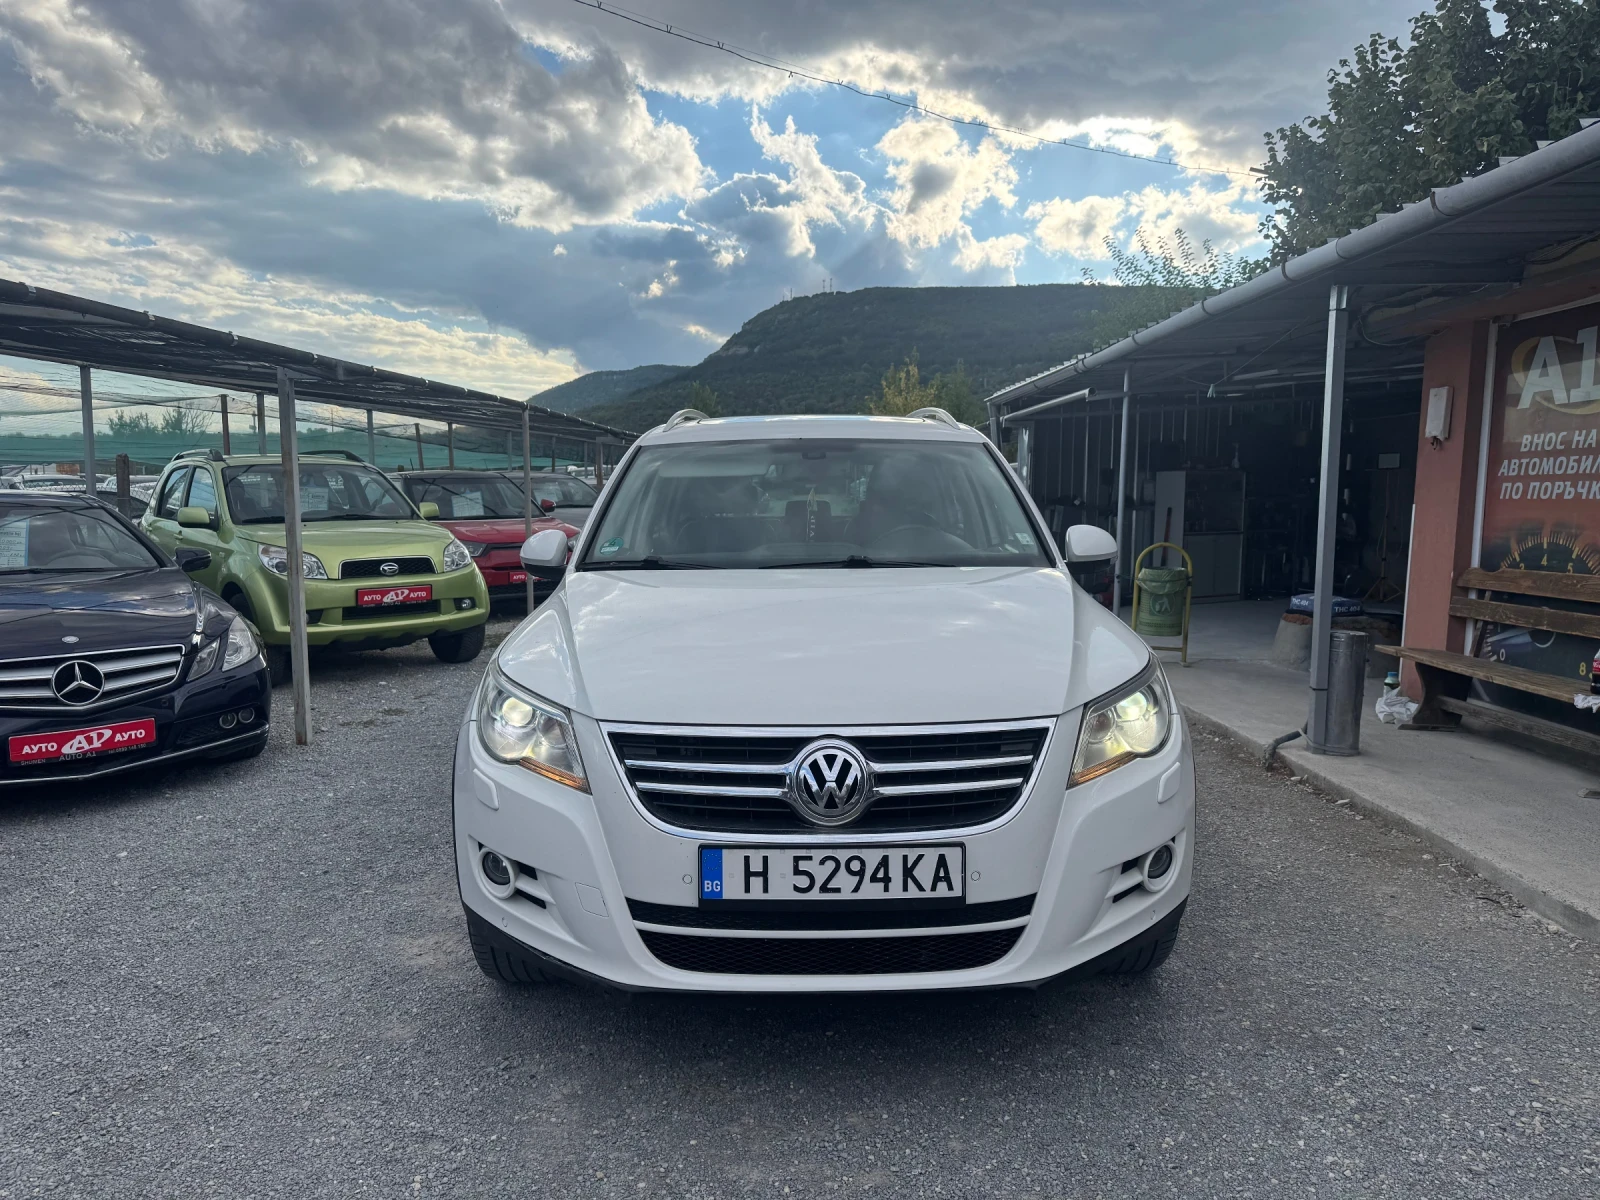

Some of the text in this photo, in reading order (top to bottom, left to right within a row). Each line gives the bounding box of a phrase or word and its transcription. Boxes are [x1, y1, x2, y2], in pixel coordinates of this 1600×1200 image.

[1517, 326, 1600, 409] A1
[1520, 429, 1598, 452] ВНОС НА
[1500, 482, 1523, 500] ПО
[1540, 554, 1548, 567] 4
[1579, 662, 1586, 676] 8
[22, 742, 57, 755] АУТО
[114, 729, 145, 743] АУТО
[59, 752, 83, 762] AUTO
[743, 855, 769, 894] H
[704, 880, 721, 892] BG
